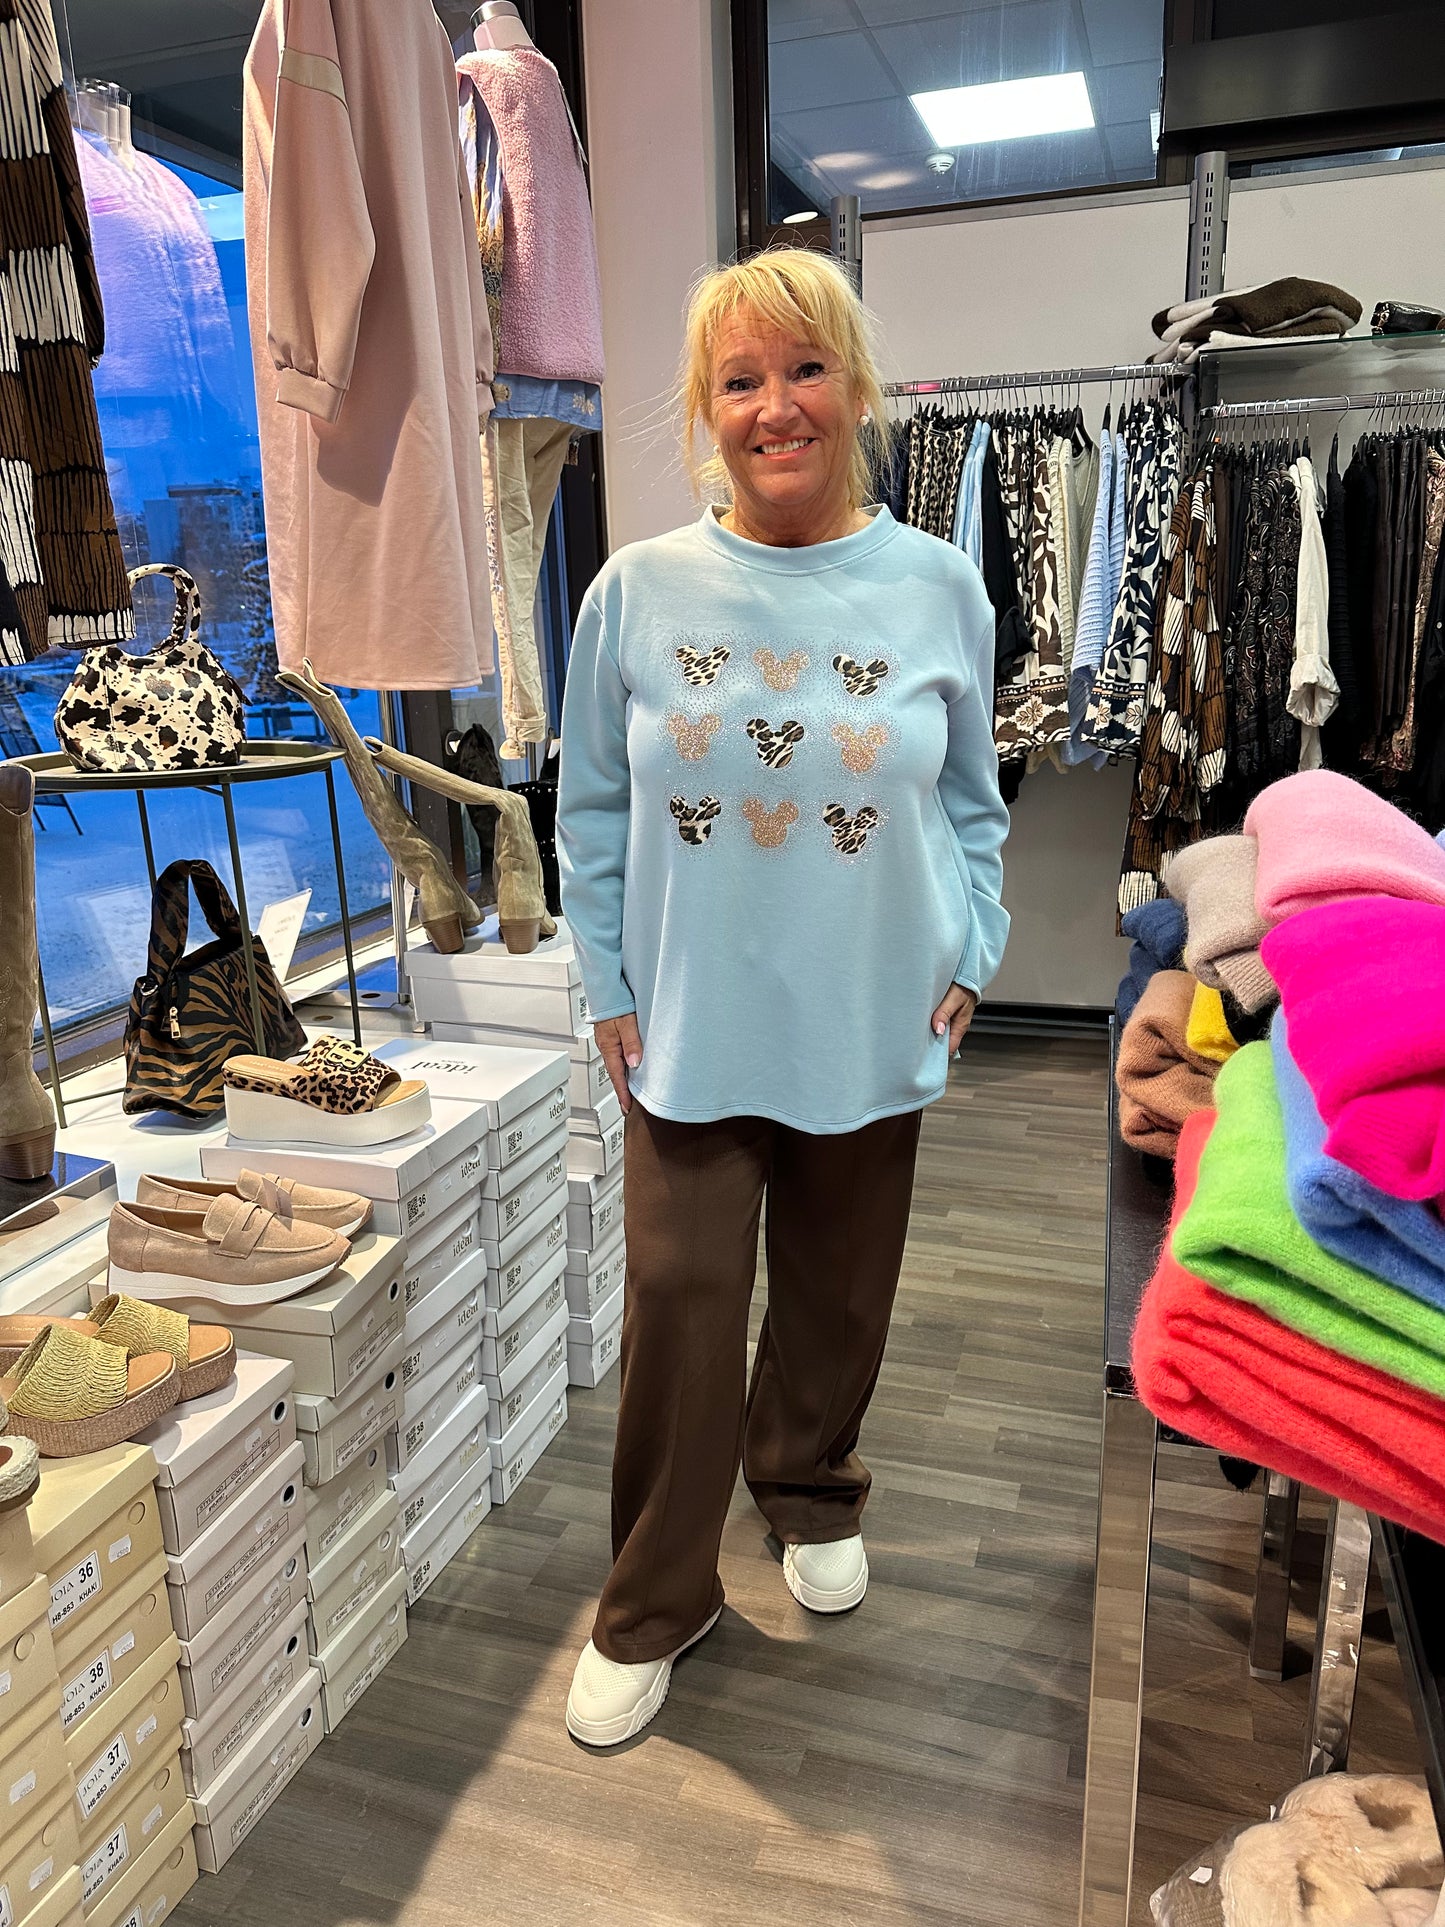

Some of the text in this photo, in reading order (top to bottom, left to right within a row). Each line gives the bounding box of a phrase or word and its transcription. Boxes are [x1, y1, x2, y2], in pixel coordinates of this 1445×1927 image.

[409, 1061, 479, 1074] ideal
[549, 1095, 566, 1119] ideal
[516, 1130, 522, 1142] 39
[460, 1160, 480, 1178] ideal
[546, 1163, 562, 1183] ideal
[418, 1194, 427, 1208] 36
[514, 1198, 520, 1210] 39
[453, 1232, 472, 1256] ideal
[547, 1224, 562, 1248] ideal
[515, 1265, 521, 1277] 39
[412, 1276, 420, 1292] 37
[546, 1288, 560, 1310] ideal
[458, 1302, 478, 1327] ideal
[513, 1332, 519, 1343] 40
[412, 1351, 421, 1366] 37
[456, 1367, 476, 1393] ideal
[516, 1394, 522, 1406] 40
[417, 1421, 424, 1435] 38
[416, 1496, 424, 1511] 38
[78, 1562, 93, 1583] 36
[423, 1560, 430, 1575] 38
[79, 1582, 98, 1602] KHAKI
[89, 1662, 104, 1683] 38
[90, 1681, 107, 1702] KHAKI
[82, 1743, 119, 1797] JOIA 37
[110, 1759, 127, 1782] KHAKI
[107, 1834, 120, 1856] 37
[108, 1852, 125, 1874] KHAKI
